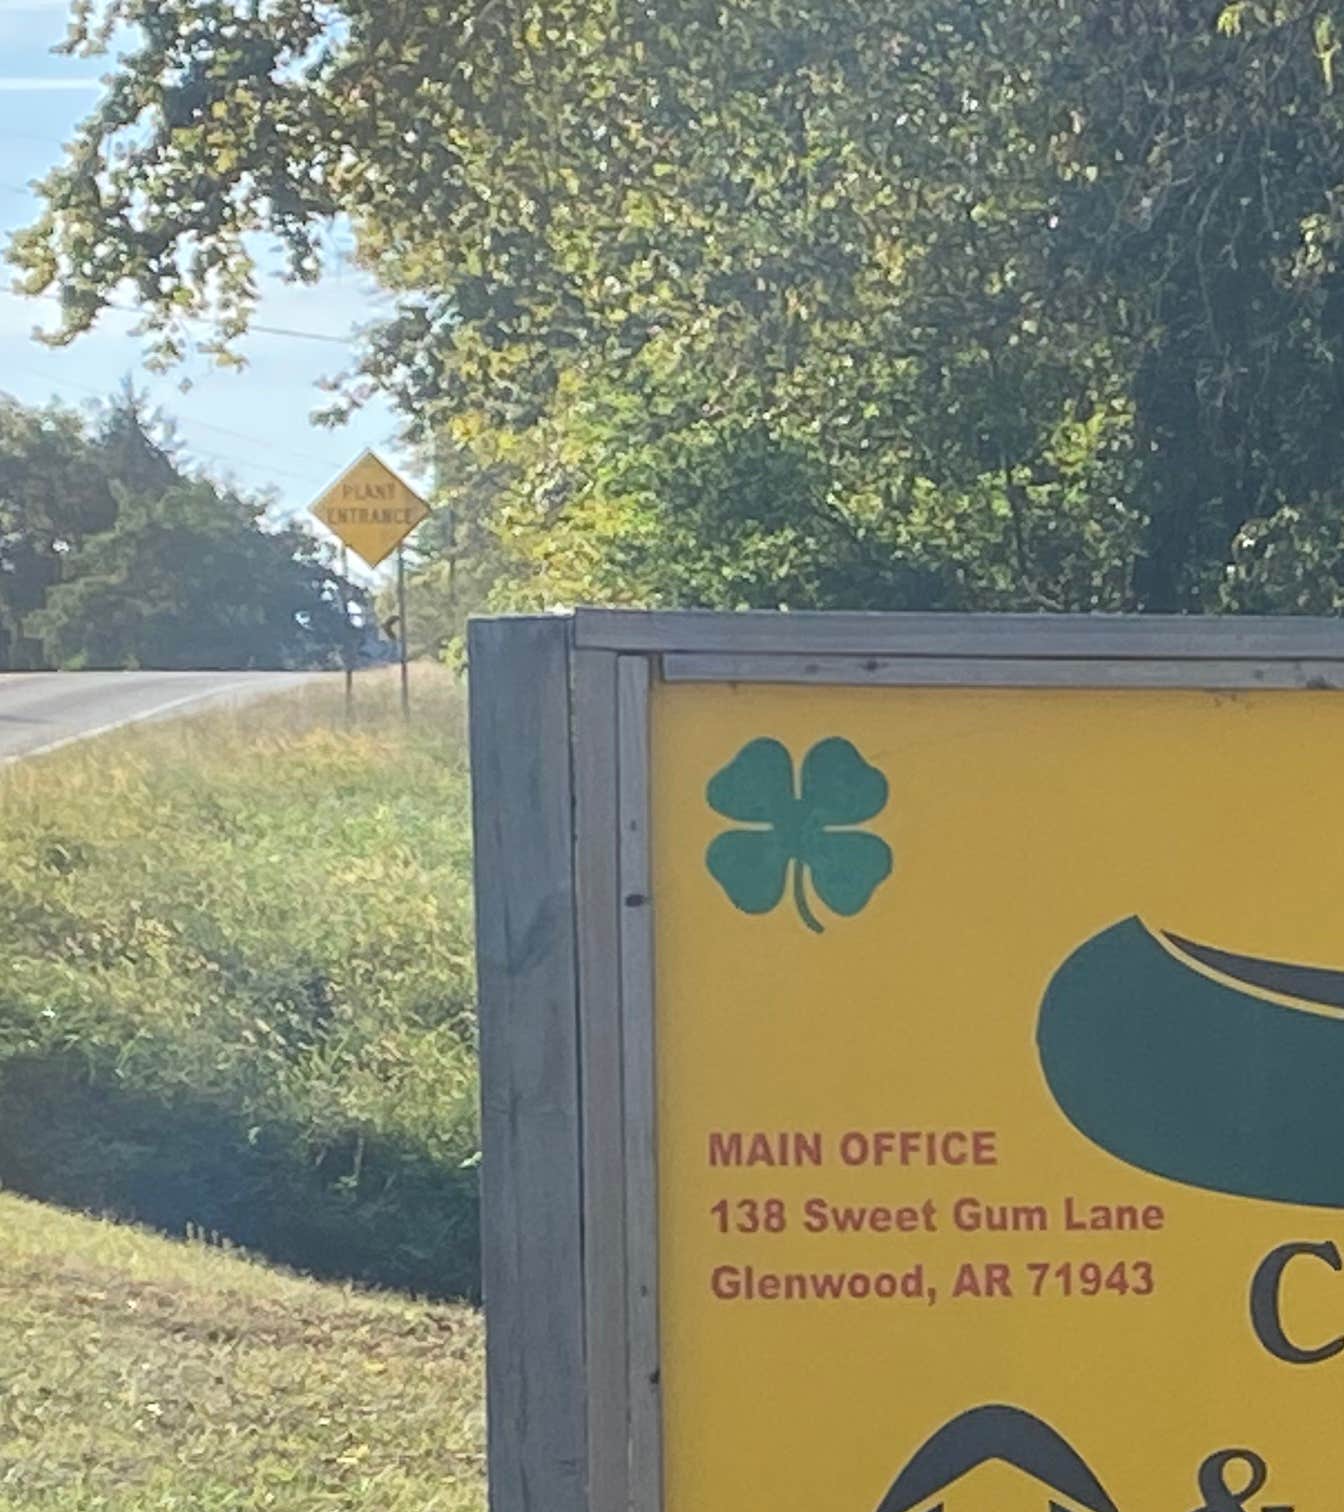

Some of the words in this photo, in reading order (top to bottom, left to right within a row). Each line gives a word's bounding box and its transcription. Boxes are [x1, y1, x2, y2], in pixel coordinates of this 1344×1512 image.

[342, 483, 396, 499] PLANT
[327, 507, 413, 525] ENTRANCE
[710, 1133, 821, 1166] MAIN
[841, 1132, 997, 1166] OFFICE
[711, 1199, 786, 1233] 138
[804, 1199, 937, 1232] Sweet
[954, 1198, 1047, 1231] Gum
[1065, 1198, 1164, 1230] Lane
[712, 1265, 936, 1306] Glenwood,
[953, 1264, 1012, 1297] AR
[1027, 1261, 1153, 1296] 71943
